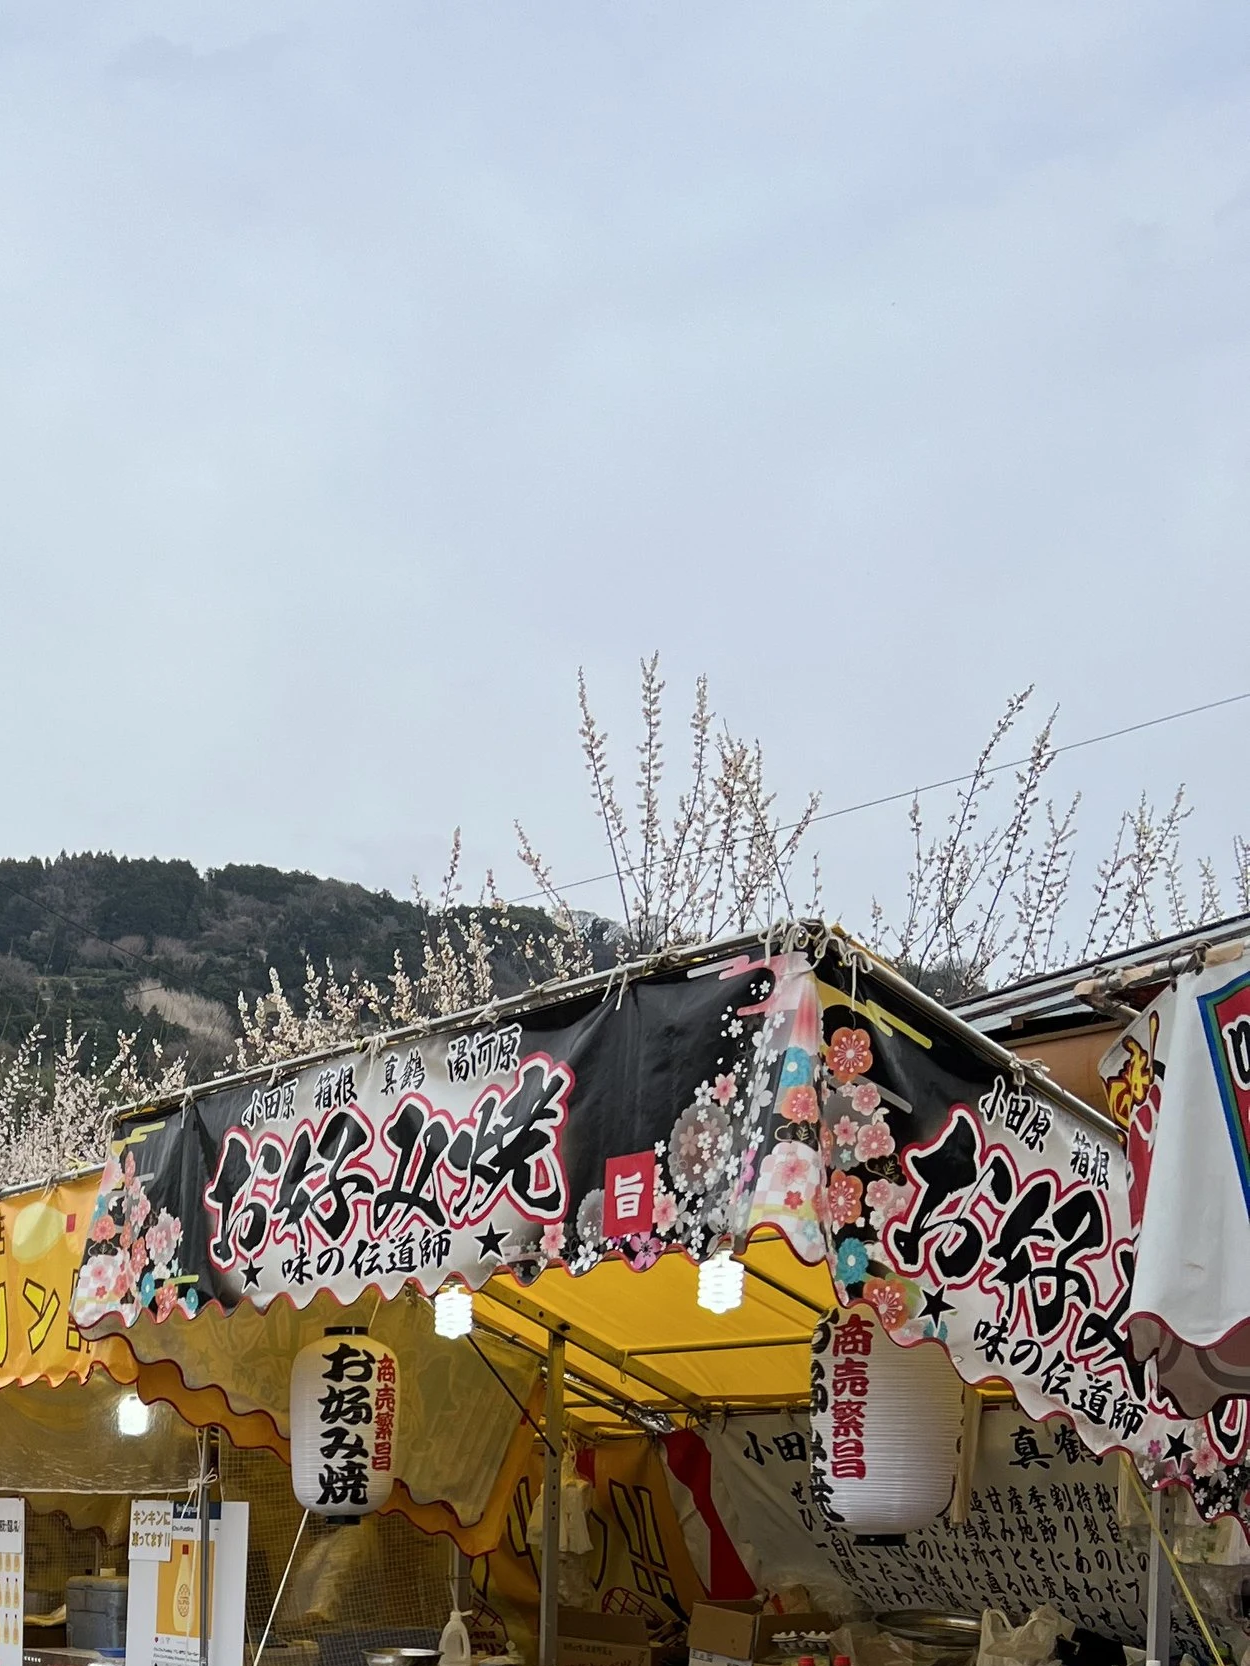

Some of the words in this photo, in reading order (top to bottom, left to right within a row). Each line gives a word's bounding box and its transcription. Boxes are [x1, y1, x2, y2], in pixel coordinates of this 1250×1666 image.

[243, 1077, 296, 1127] 小田原
[314, 1063, 355, 1112] 箱根
[380, 1047, 426, 1096] 真鶴
[448, 1023, 522, 1084] 湯河原
[980, 1075, 1053, 1154] 小田原
[1070, 1131, 1112, 1192] 箱根
[210, 1056, 570, 1268] お好み焼
[280, 1228, 453, 1284] 味の伝道師
[974, 1319, 1147, 1439] 味の伝道師
